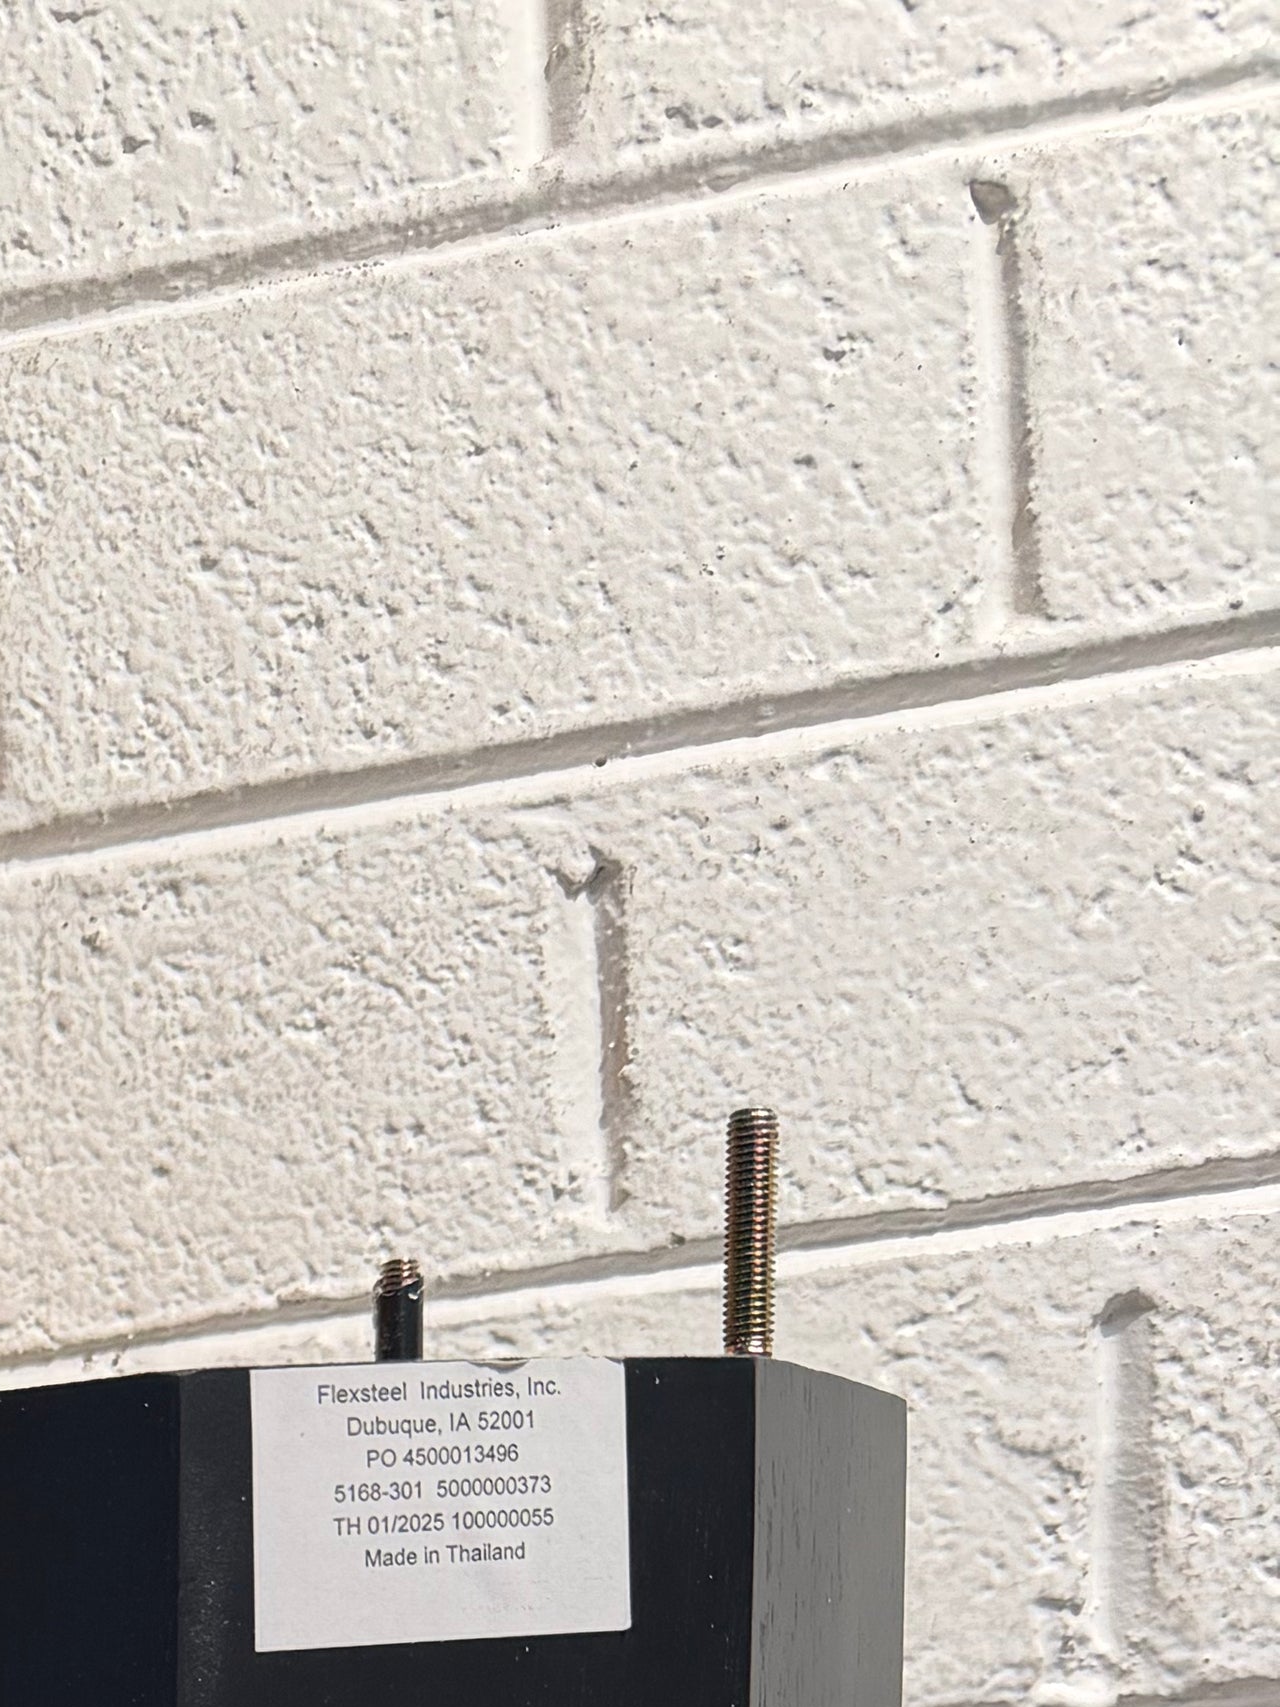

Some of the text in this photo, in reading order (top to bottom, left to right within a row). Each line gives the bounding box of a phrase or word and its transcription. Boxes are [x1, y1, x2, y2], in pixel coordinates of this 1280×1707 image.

[318, 1377, 560, 1404] Flexsteel Industries, Inc.
[348, 1410, 533, 1438] Dubuque, IA 52001
[367, 1444, 518, 1468] PO 4500013496
[335, 1475, 551, 1503] 5168-301 5000000373
[333, 1508, 553, 1536] TH 01/2025 100000055
[366, 1542, 525, 1567] Made in Thailand
